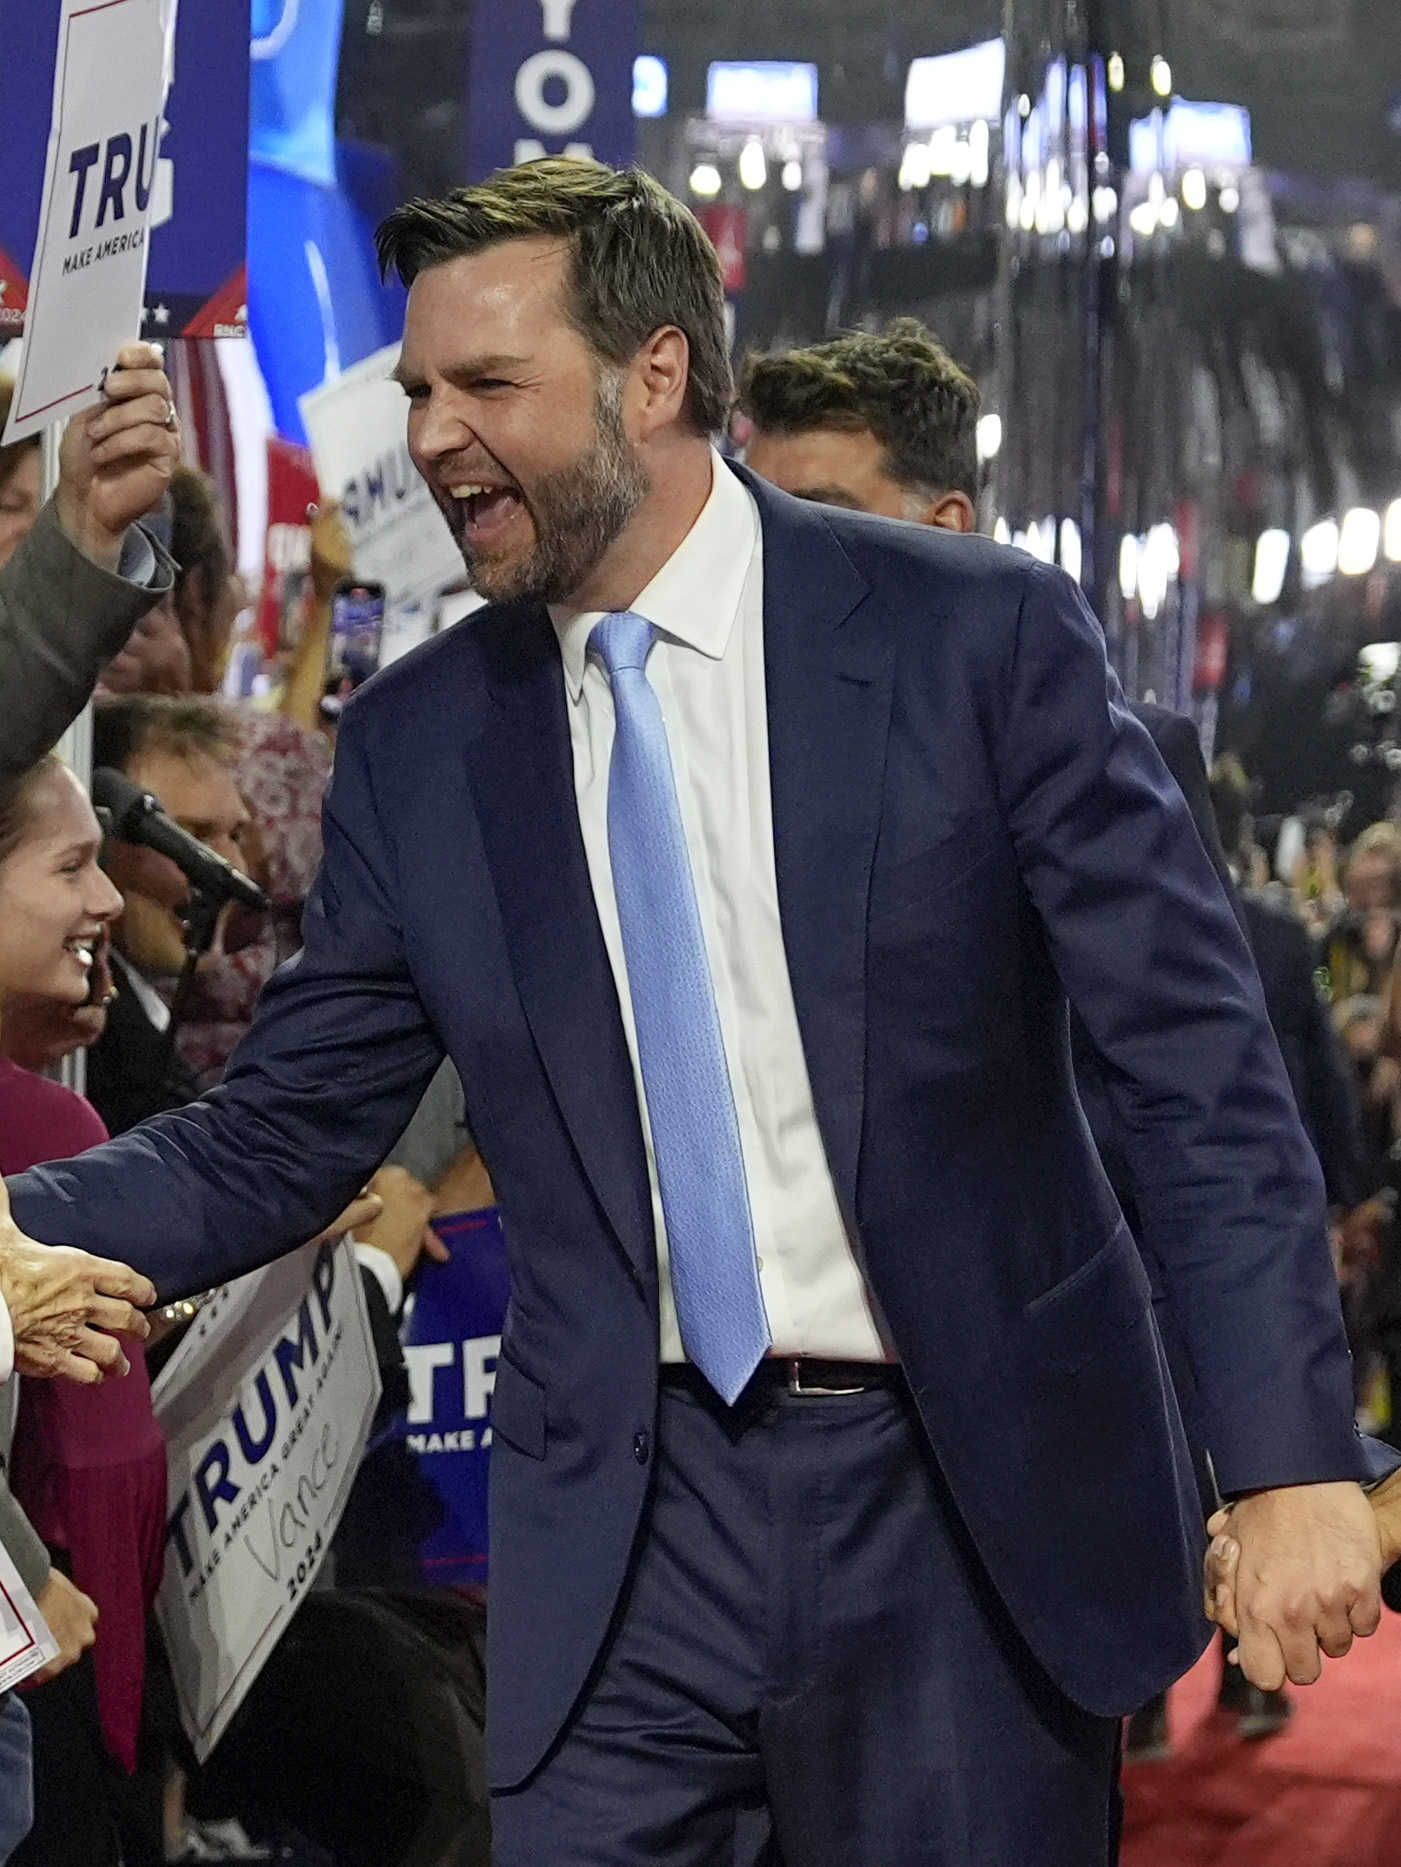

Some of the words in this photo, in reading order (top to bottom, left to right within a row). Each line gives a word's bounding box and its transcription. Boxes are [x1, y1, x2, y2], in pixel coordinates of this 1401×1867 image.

[61, 246, 94, 276] MAKE
[166, 1238, 334, 1579] TRUMP
[405, 1429, 476, 1453] MAKE
[223, 1462, 280, 1549] AMERICA
[243, 1422, 340, 1583] Vance
[286, 1528, 323, 1603] 2024
